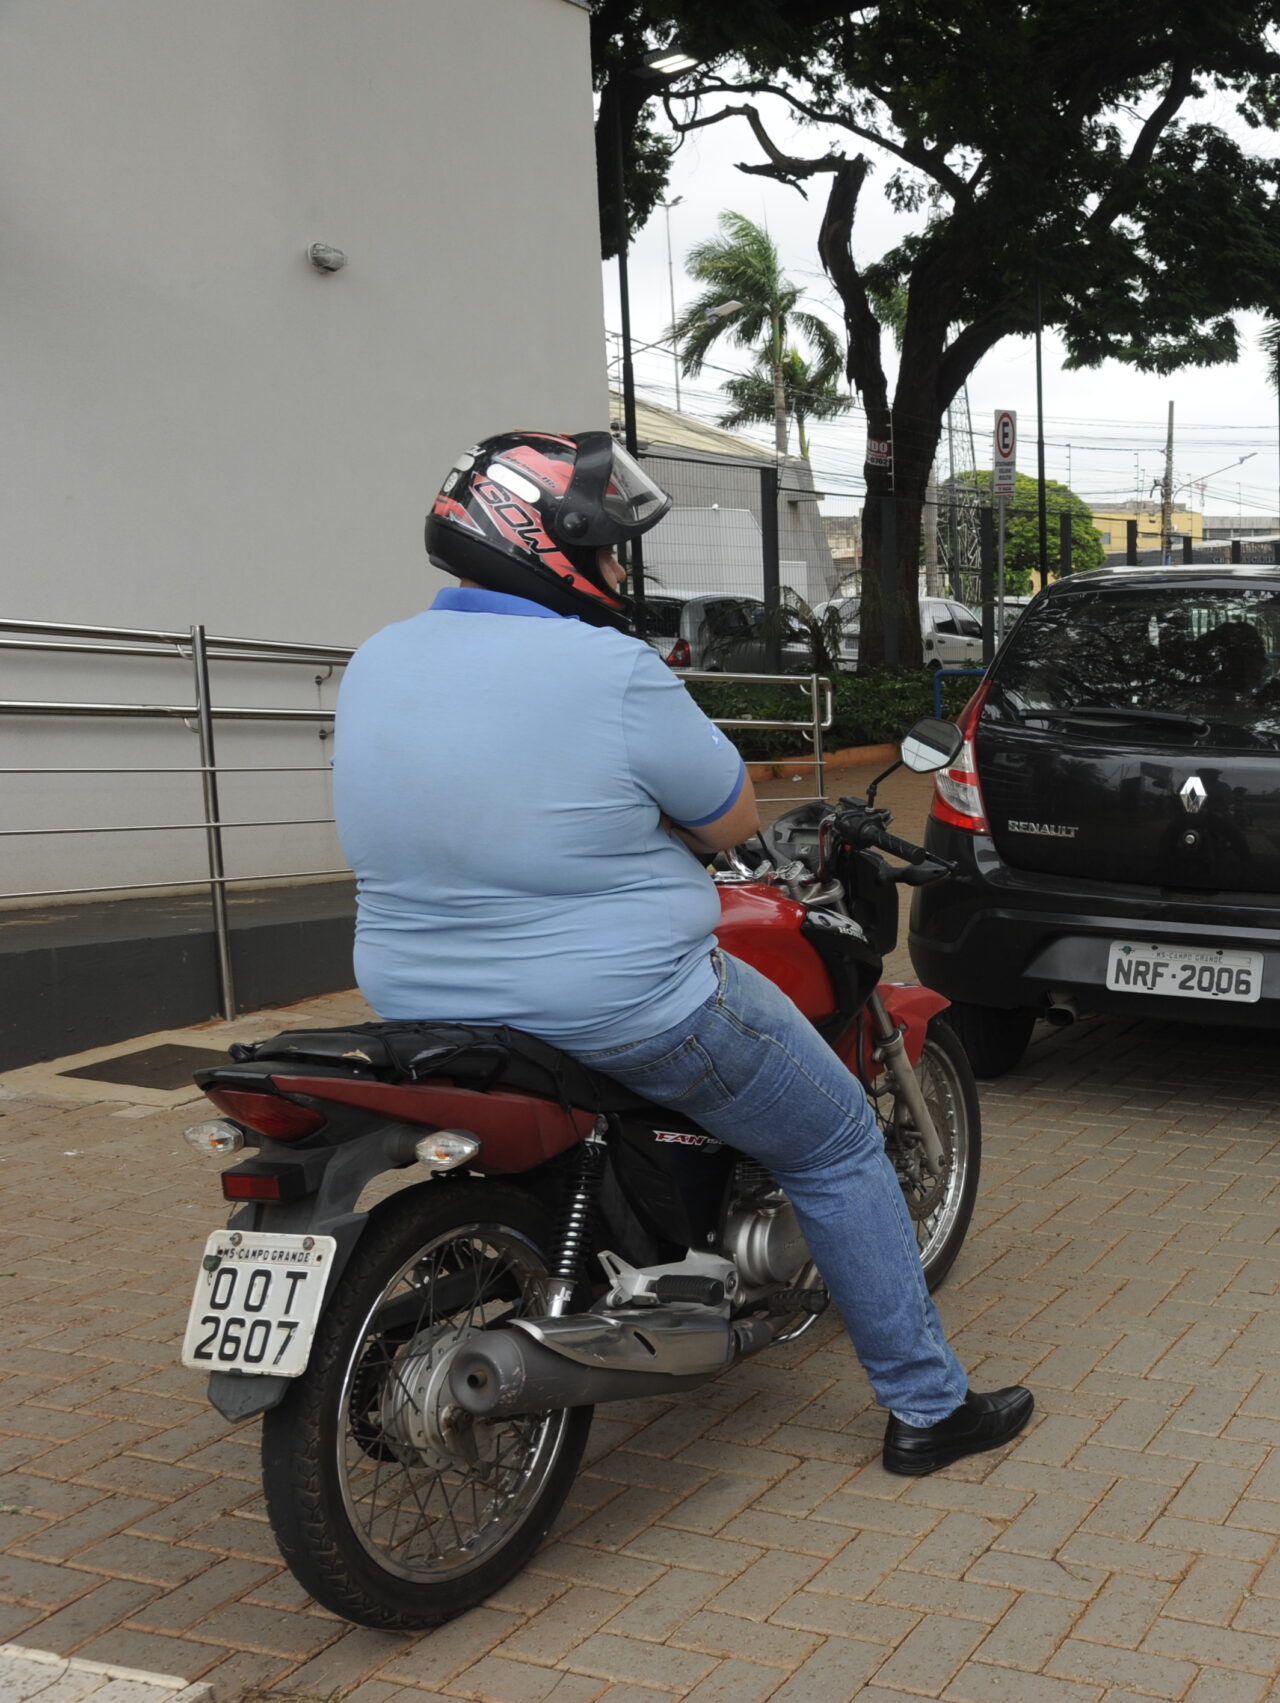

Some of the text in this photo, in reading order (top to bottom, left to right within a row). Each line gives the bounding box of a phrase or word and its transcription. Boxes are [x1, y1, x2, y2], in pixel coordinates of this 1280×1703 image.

[1002, 421, 1010, 449] E
[1008, 819, 1079, 838] RENAULT
[1195, 953, 1224, 964] GRANDE
[652, 1129, 708, 1146] FAN
[271, 1250, 310, 1263] GRANDE
[193, 1315, 300, 1365] 2607
